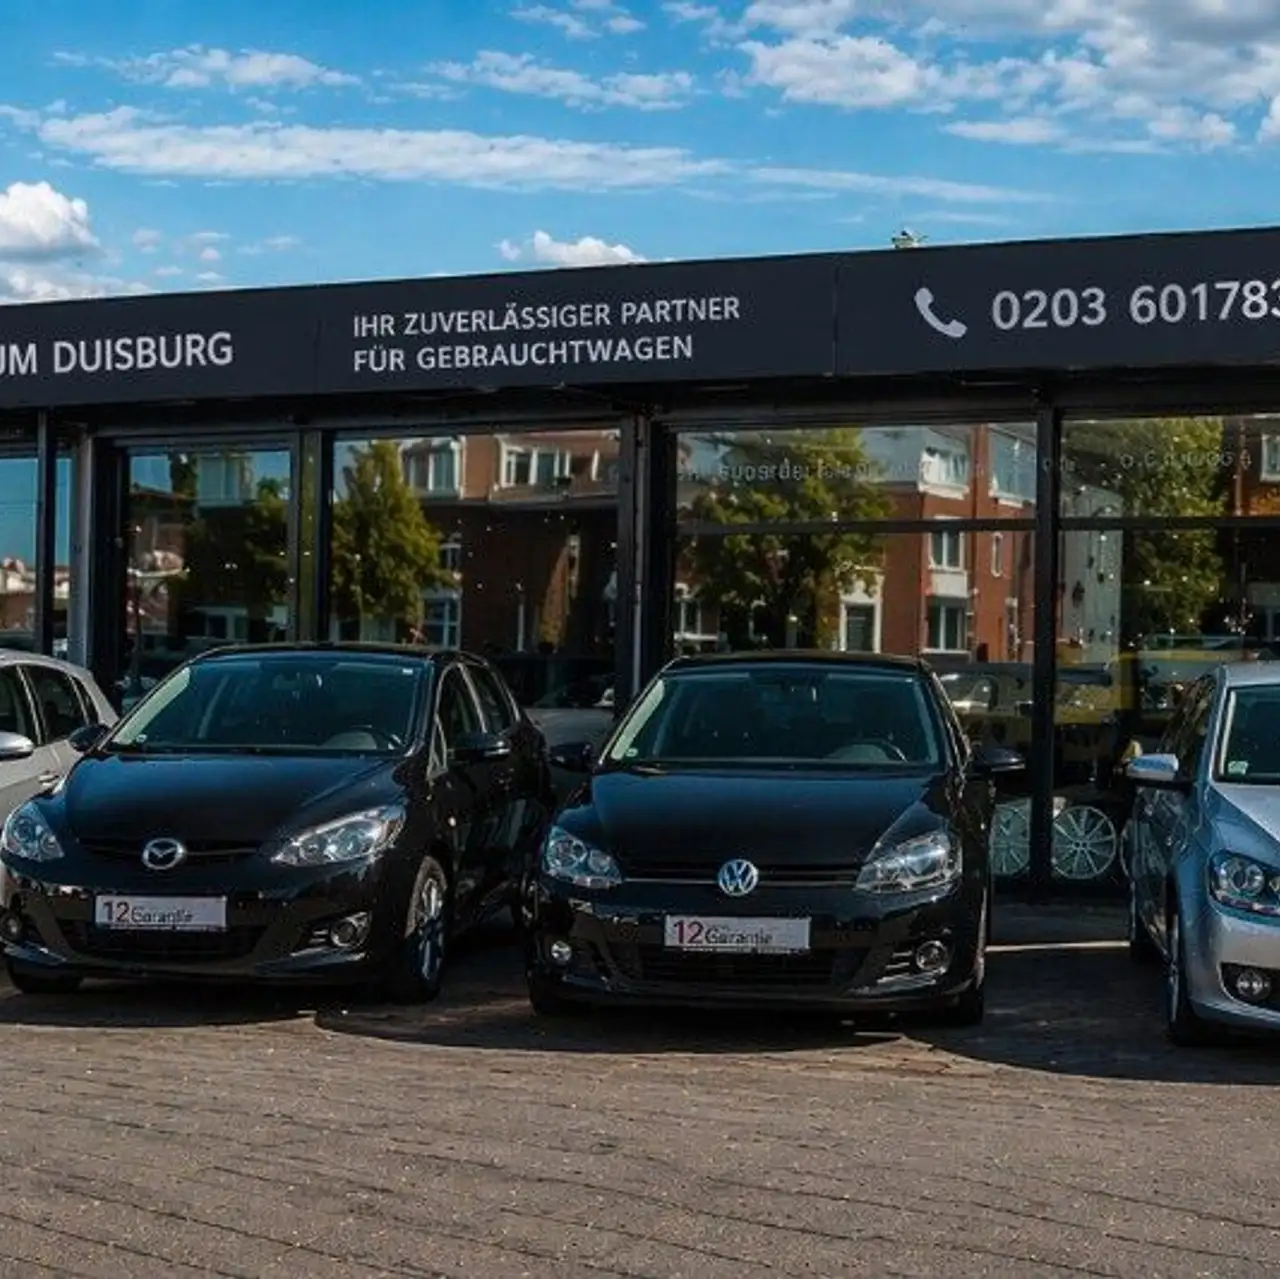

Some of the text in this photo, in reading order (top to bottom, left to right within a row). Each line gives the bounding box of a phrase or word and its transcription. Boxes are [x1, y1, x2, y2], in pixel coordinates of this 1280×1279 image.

[353, 296, 741, 338] IHR ZUVERLÄSSIGER PARTNER
[992, 287, 1107, 330] 0203
[53, 331, 234, 374] DUISBURG
[353, 334, 693, 373] FÜR GEBRAUCHTWAGEN
[103, 901, 130, 922] 12
[673, 919, 704, 945] 12
